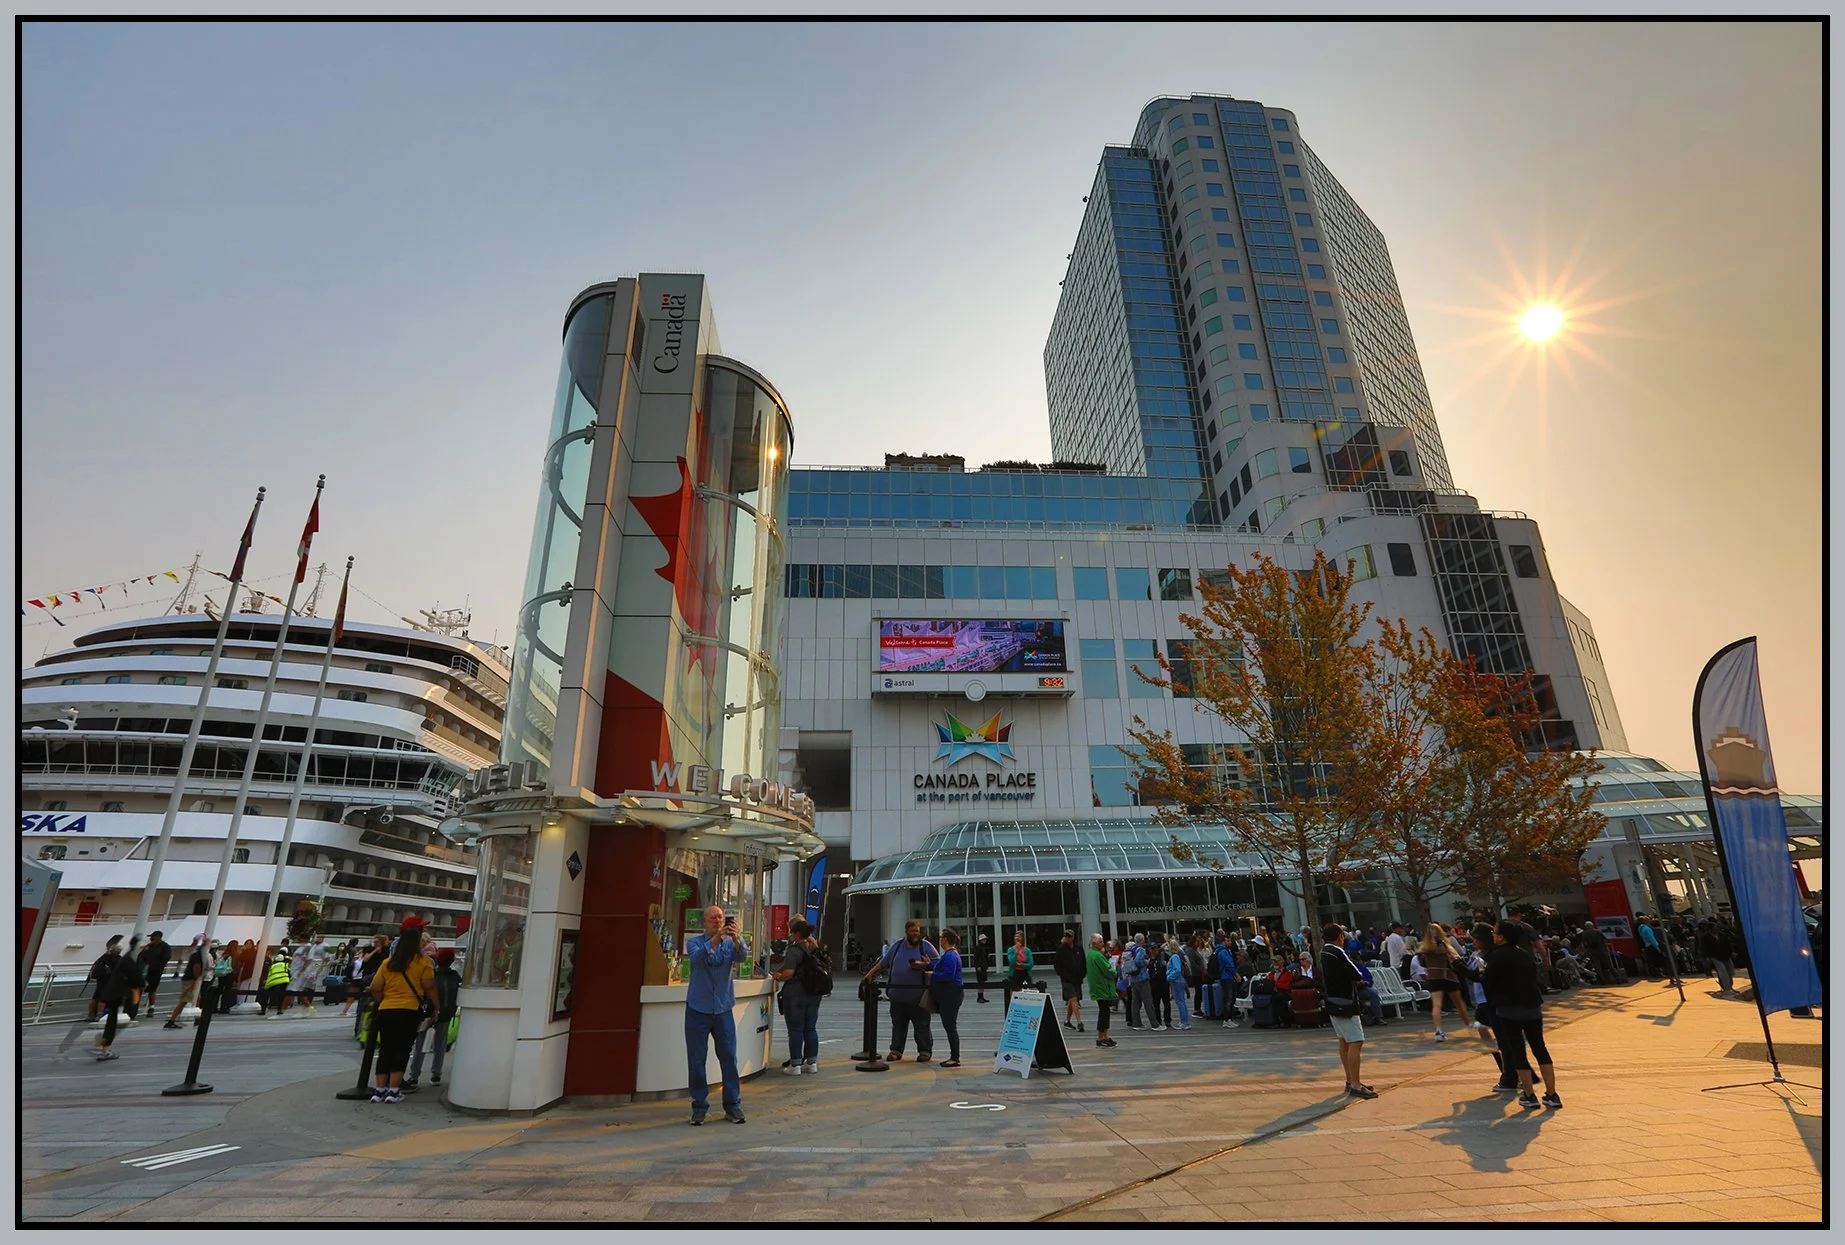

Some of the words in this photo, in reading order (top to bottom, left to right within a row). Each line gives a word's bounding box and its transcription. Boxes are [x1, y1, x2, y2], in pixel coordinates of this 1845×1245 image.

[653, 293, 687, 374] Canada
[893, 679, 915, 687] astral
[1043, 677, 1064, 687] 9:32
[650, 759, 797, 811] WELCOME
[914, 773, 980, 789] CANADA
[986, 772, 1037, 788] PLACE
[917, 792, 927, 802] at
[929, 791, 945, 802] the
[948, 792, 970, 804] port
[971, 790, 982, 801] of
[983, 792, 1035, 801] vancouver
[1128, 905, 1174, 914] VANCOUVER
[1176, 903, 1225, 912] CONVENTION
[1226, 902, 1256, 911] CENTRE
